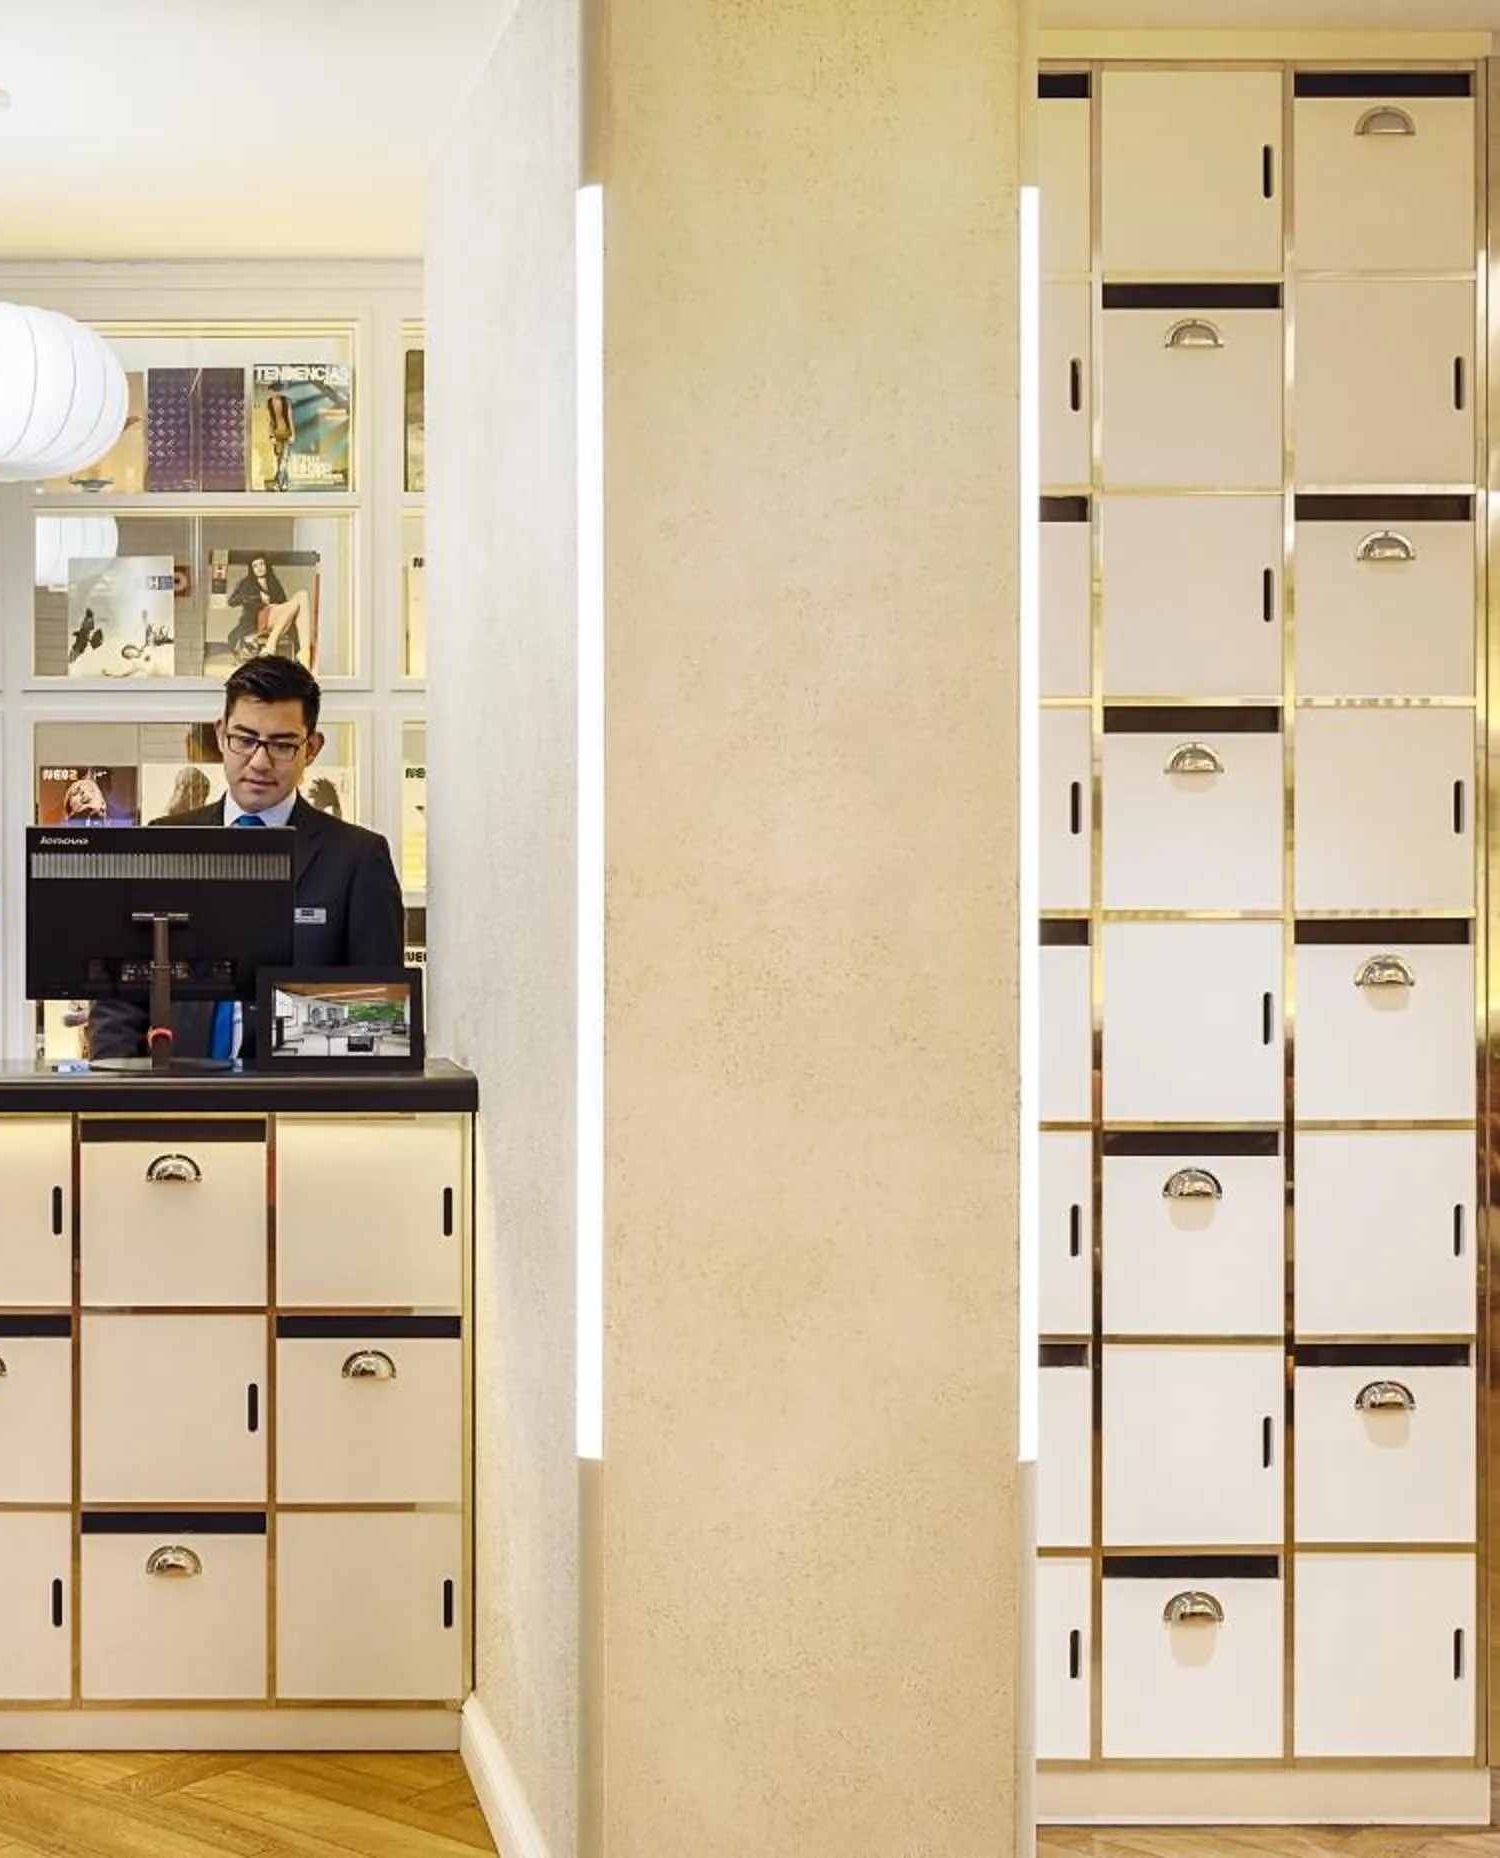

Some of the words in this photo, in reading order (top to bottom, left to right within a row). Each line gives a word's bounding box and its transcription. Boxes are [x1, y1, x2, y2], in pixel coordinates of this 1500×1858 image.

[43, 769, 78, 781] NEO2
[405, 767, 425, 779] NE
[40, 836, 89, 845] lenovo
